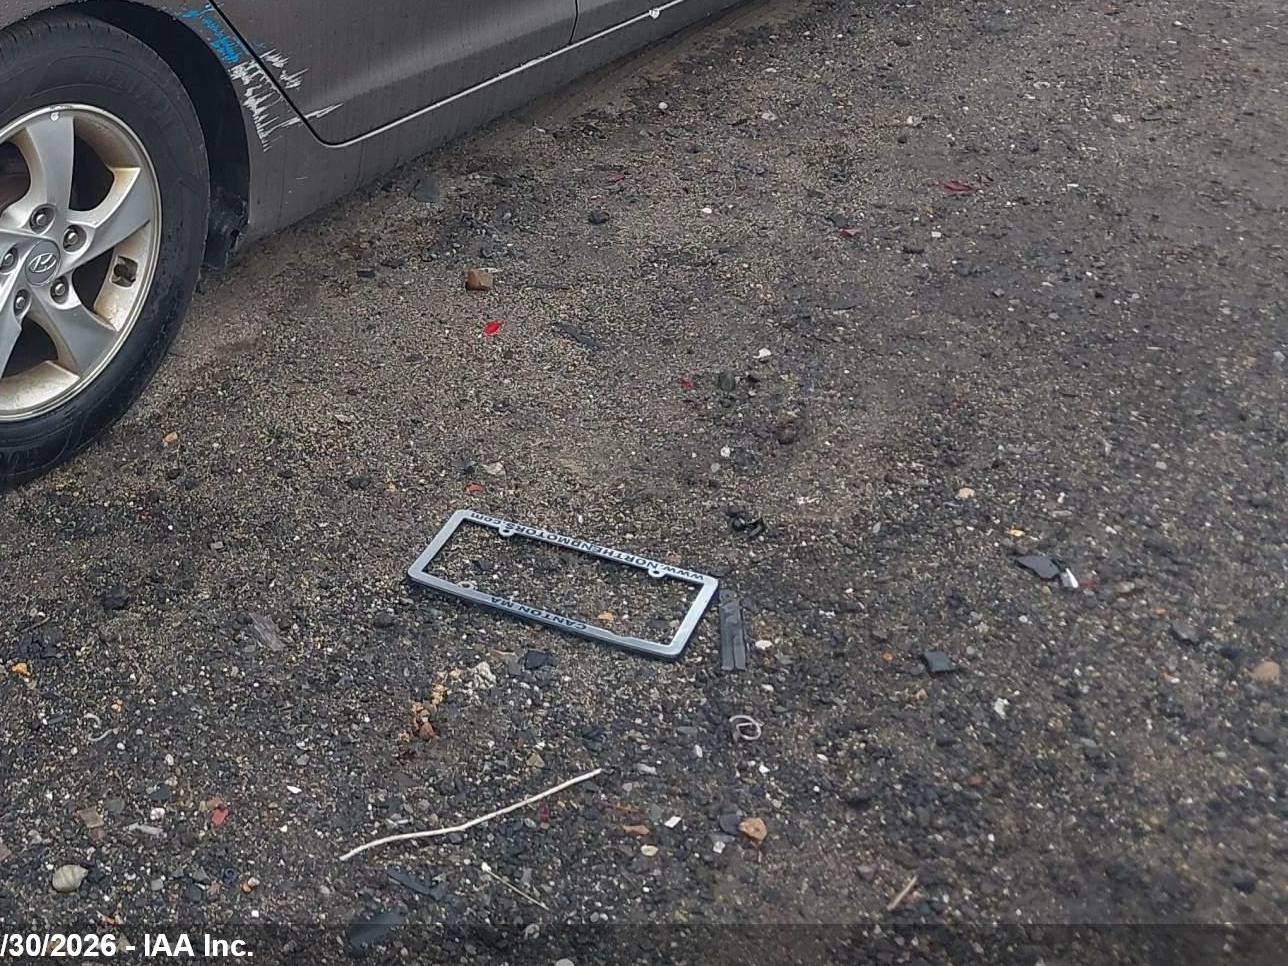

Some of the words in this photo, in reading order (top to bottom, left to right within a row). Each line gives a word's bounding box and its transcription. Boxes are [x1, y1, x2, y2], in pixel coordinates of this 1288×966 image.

[470, 512, 705, 581] www.NORTHENDMOTORS.com
[490, 596, 515, 608] MA
[518, 605, 587, 630] CANTON
